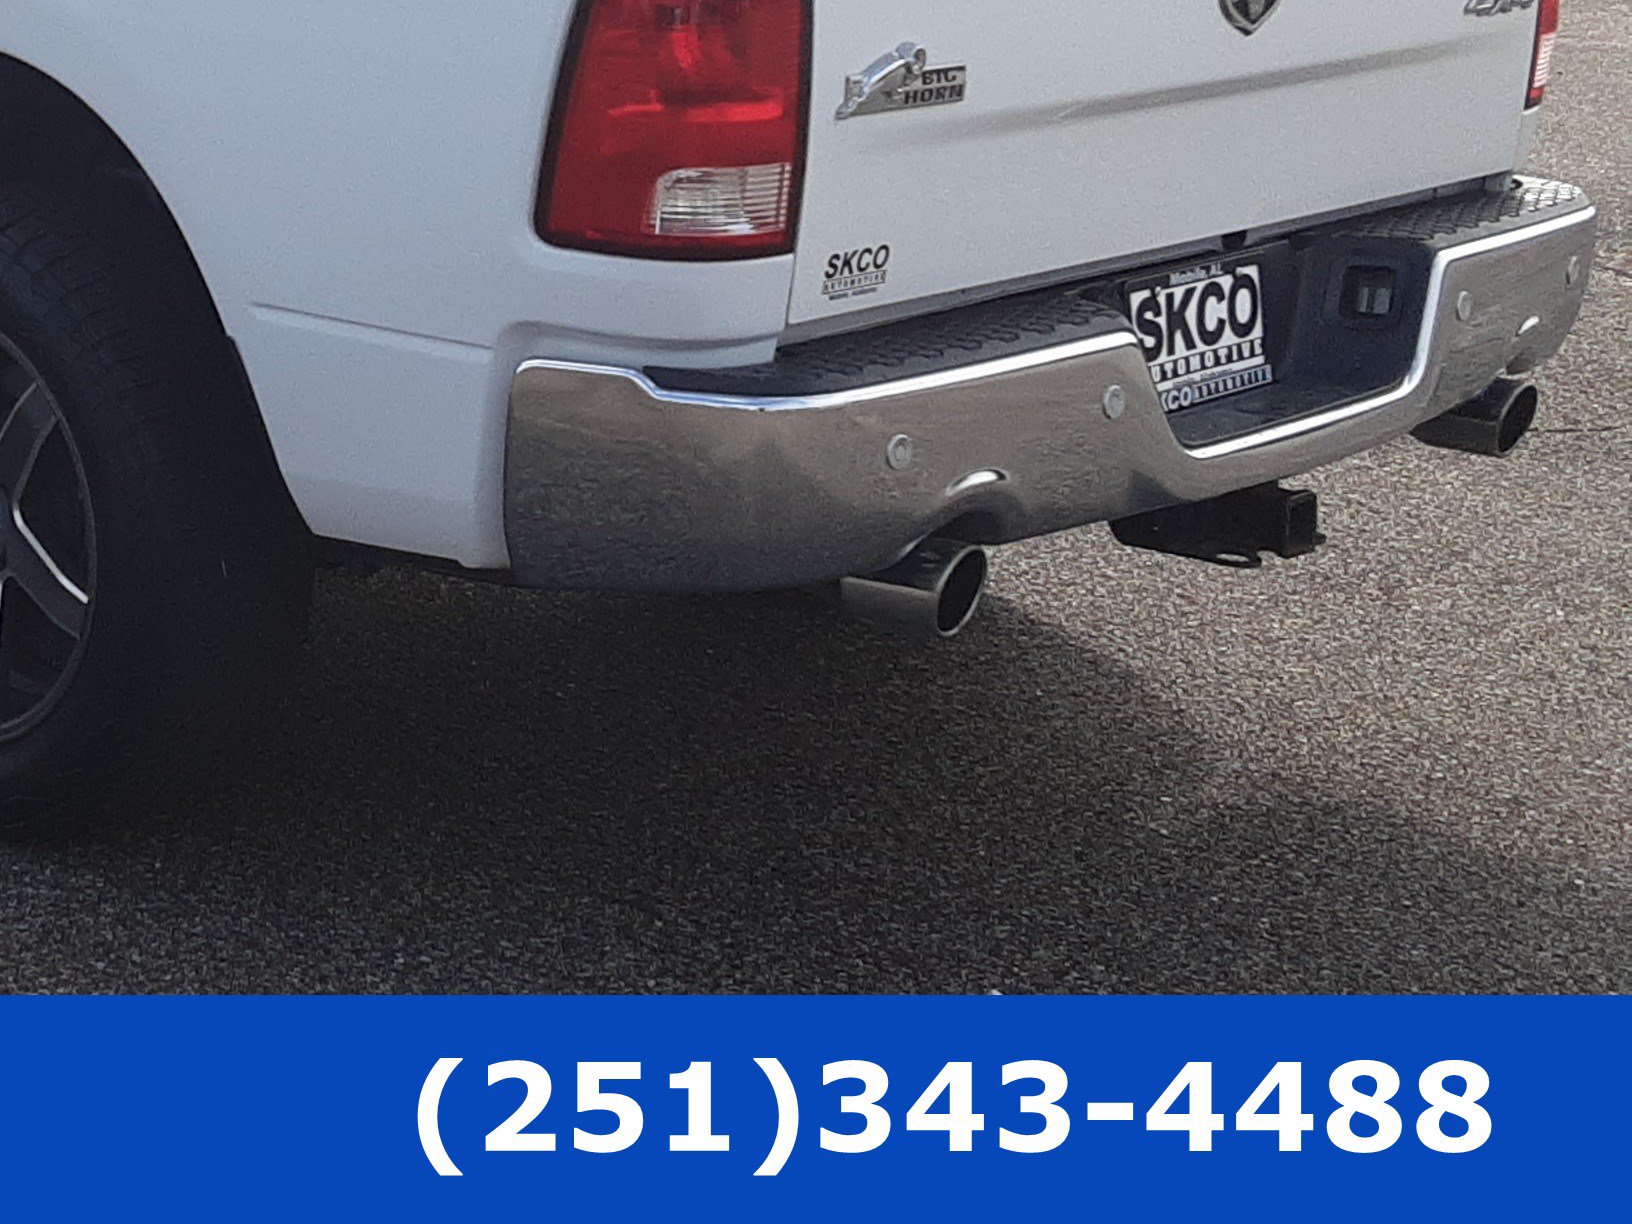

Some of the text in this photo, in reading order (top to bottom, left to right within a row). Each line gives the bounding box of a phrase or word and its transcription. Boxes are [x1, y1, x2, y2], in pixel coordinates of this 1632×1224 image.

[904, 83, 965, 105] HORN
[922, 69, 958, 85] BIG
[824, 244, 890, 279] SKCO
[1136, 273, 1259, 363] SKCO
[1150, 338, 1263, 383] UTOMOTIVE
